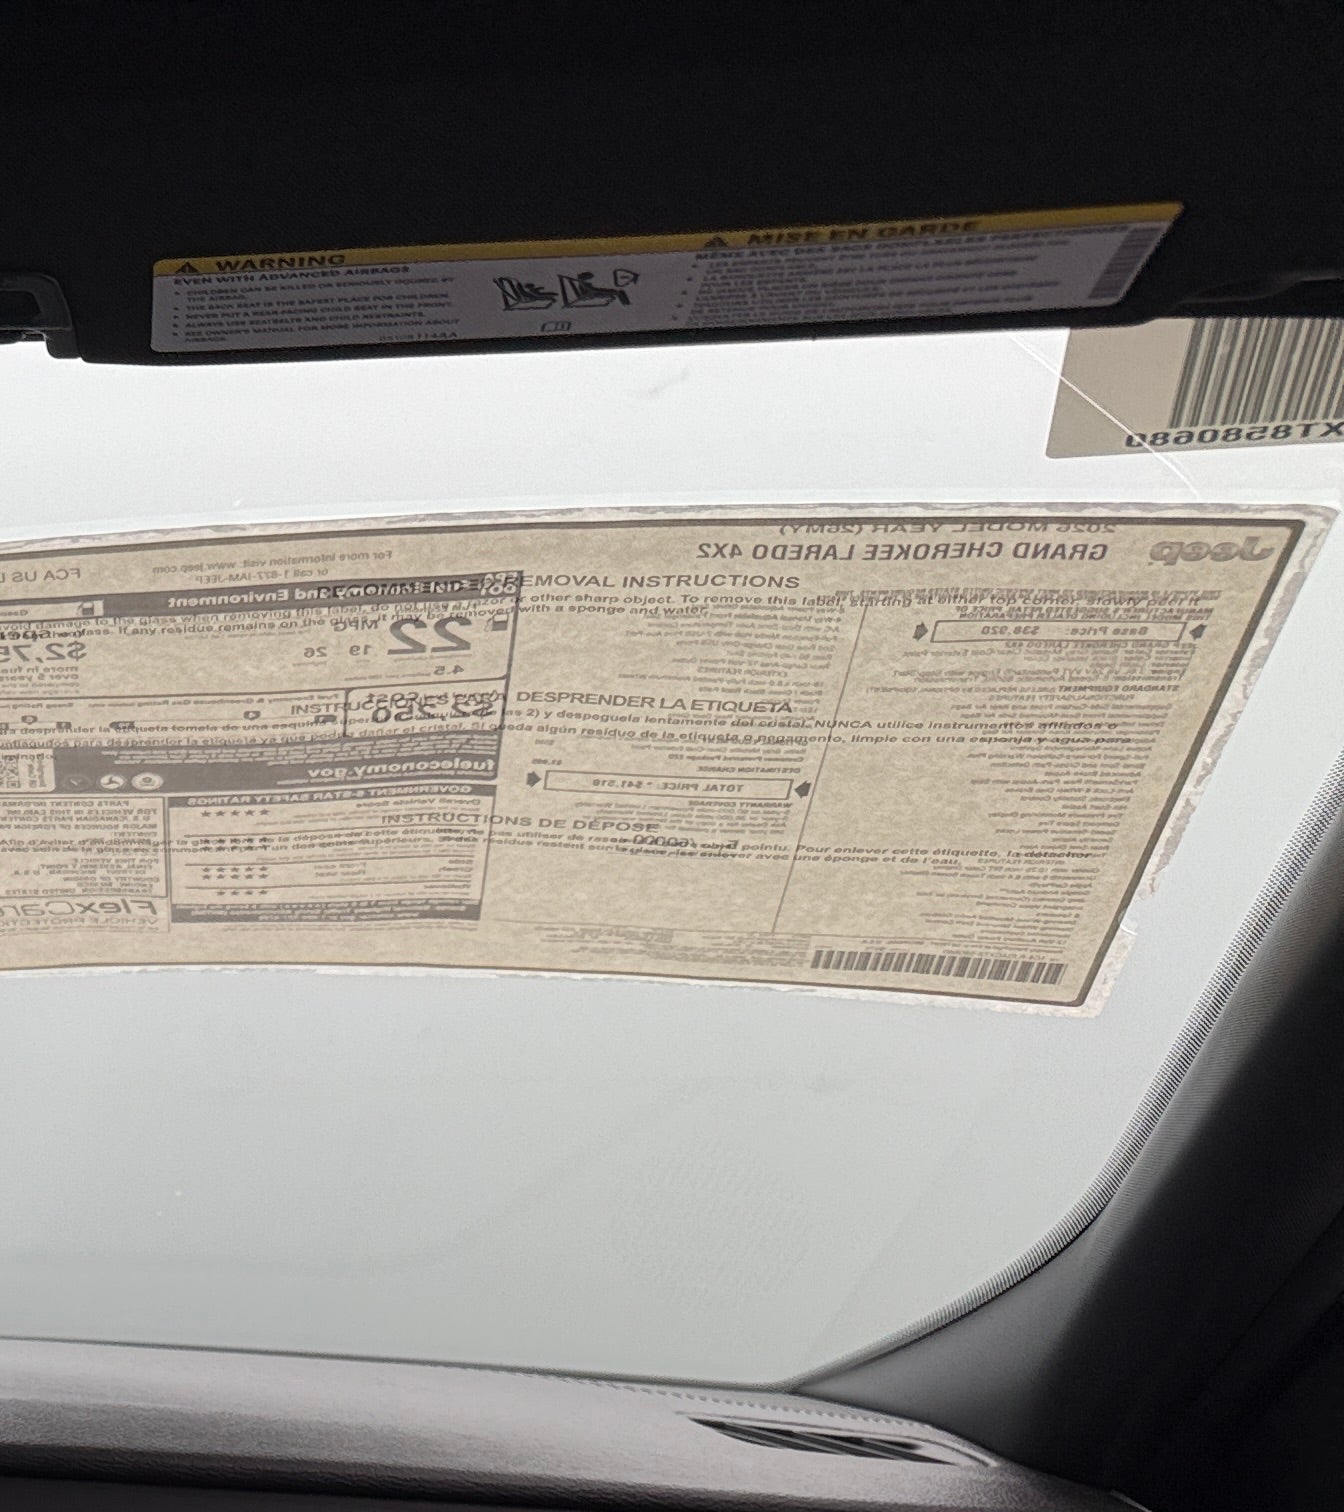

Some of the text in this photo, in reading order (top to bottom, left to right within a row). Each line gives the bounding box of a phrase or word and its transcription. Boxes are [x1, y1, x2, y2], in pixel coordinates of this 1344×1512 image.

[215, 255, 346, 271] WARNING
[174, 266, 410, 285] EVEN WITH ADVANCED AIRBAGS
[622, 574, 801, 589] INSTRUCTIONS
[516, 691, 793, 713] DESPRENDER LA ETIQUETA
[538, 818, 565, 829] DE
